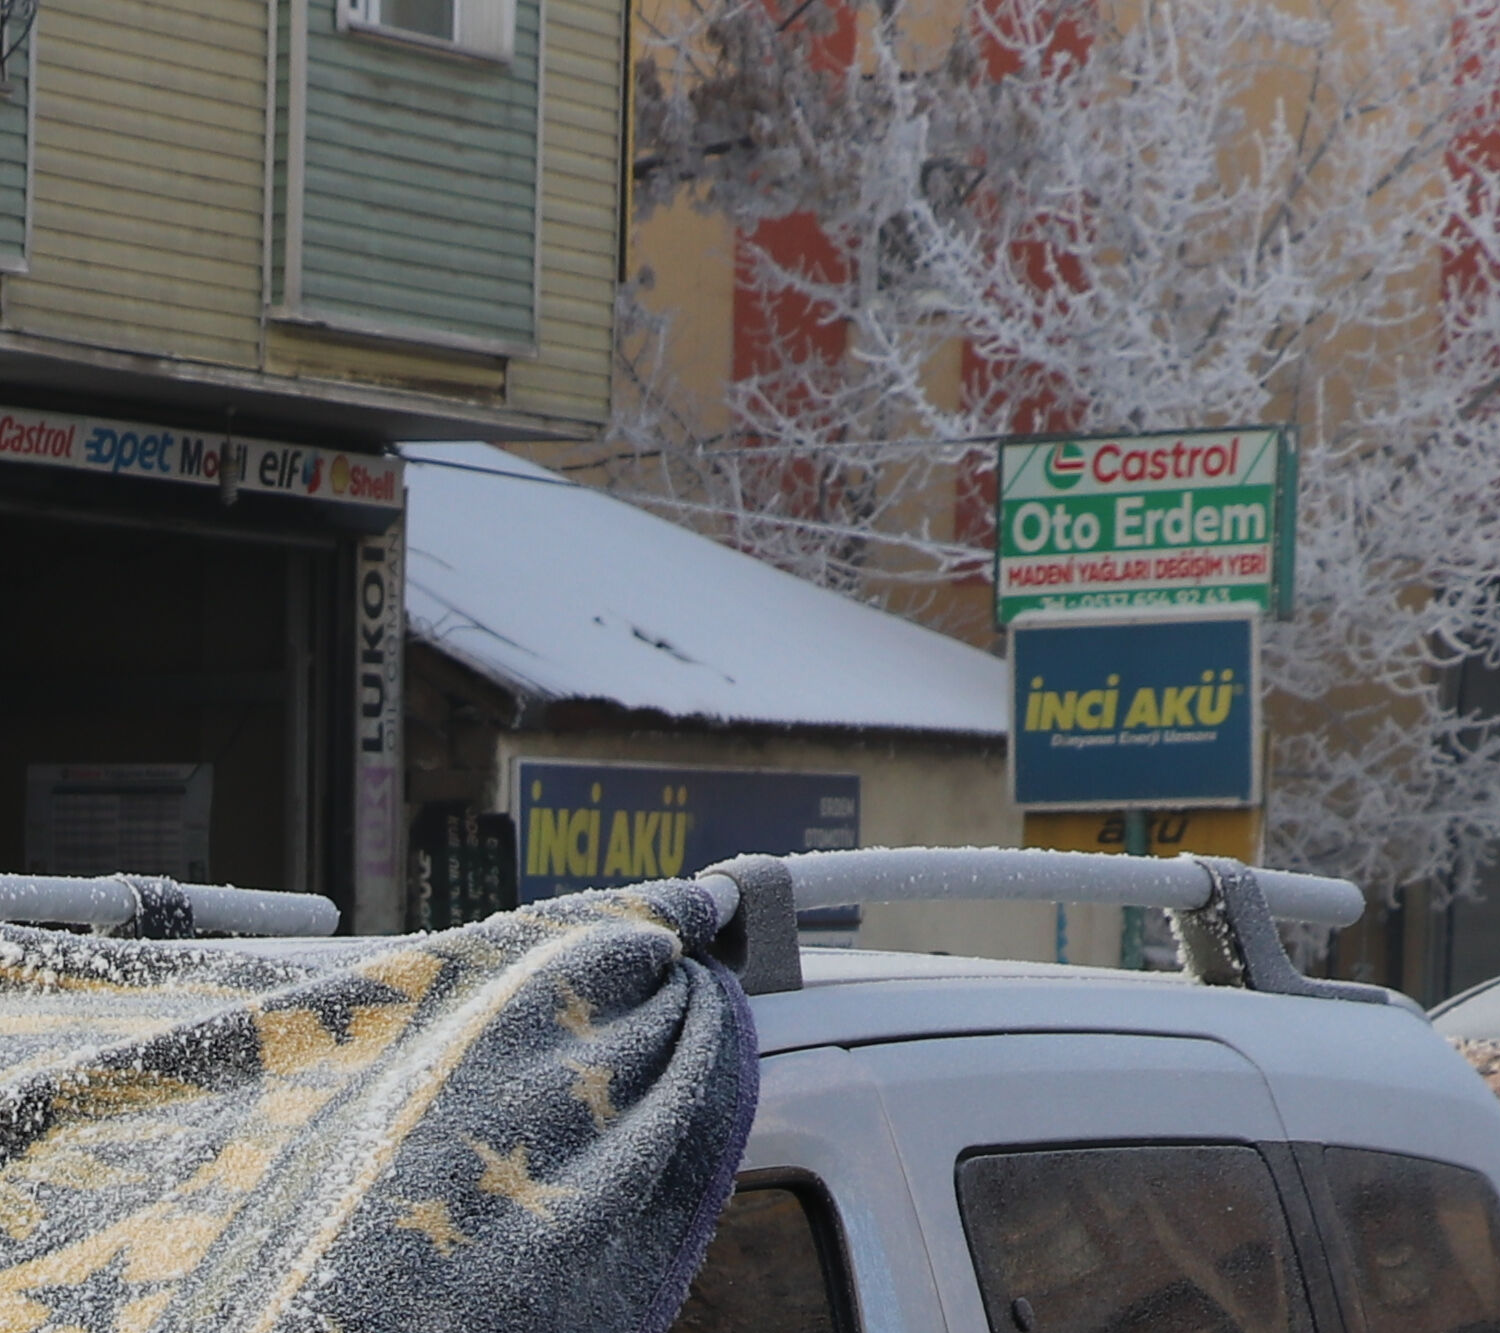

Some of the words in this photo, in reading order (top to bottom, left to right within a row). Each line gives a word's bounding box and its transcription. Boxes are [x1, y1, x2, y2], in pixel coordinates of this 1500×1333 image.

[260, 450, 303, 489] elf
[350, 464, 396, 501] Shell
[1092, 437, 1239, 484] Castrol
[1013, 502, 1101, 554] Oto
[1115, 491, 1267, 548] Erdem
[1079, 554, 1151, 583] YAĞLARI
[1227, 545, 1267, 576] YERİ
[1122, 668, 1234, 730] AKÜ
[603, 784, 688, 878] AKÜ
